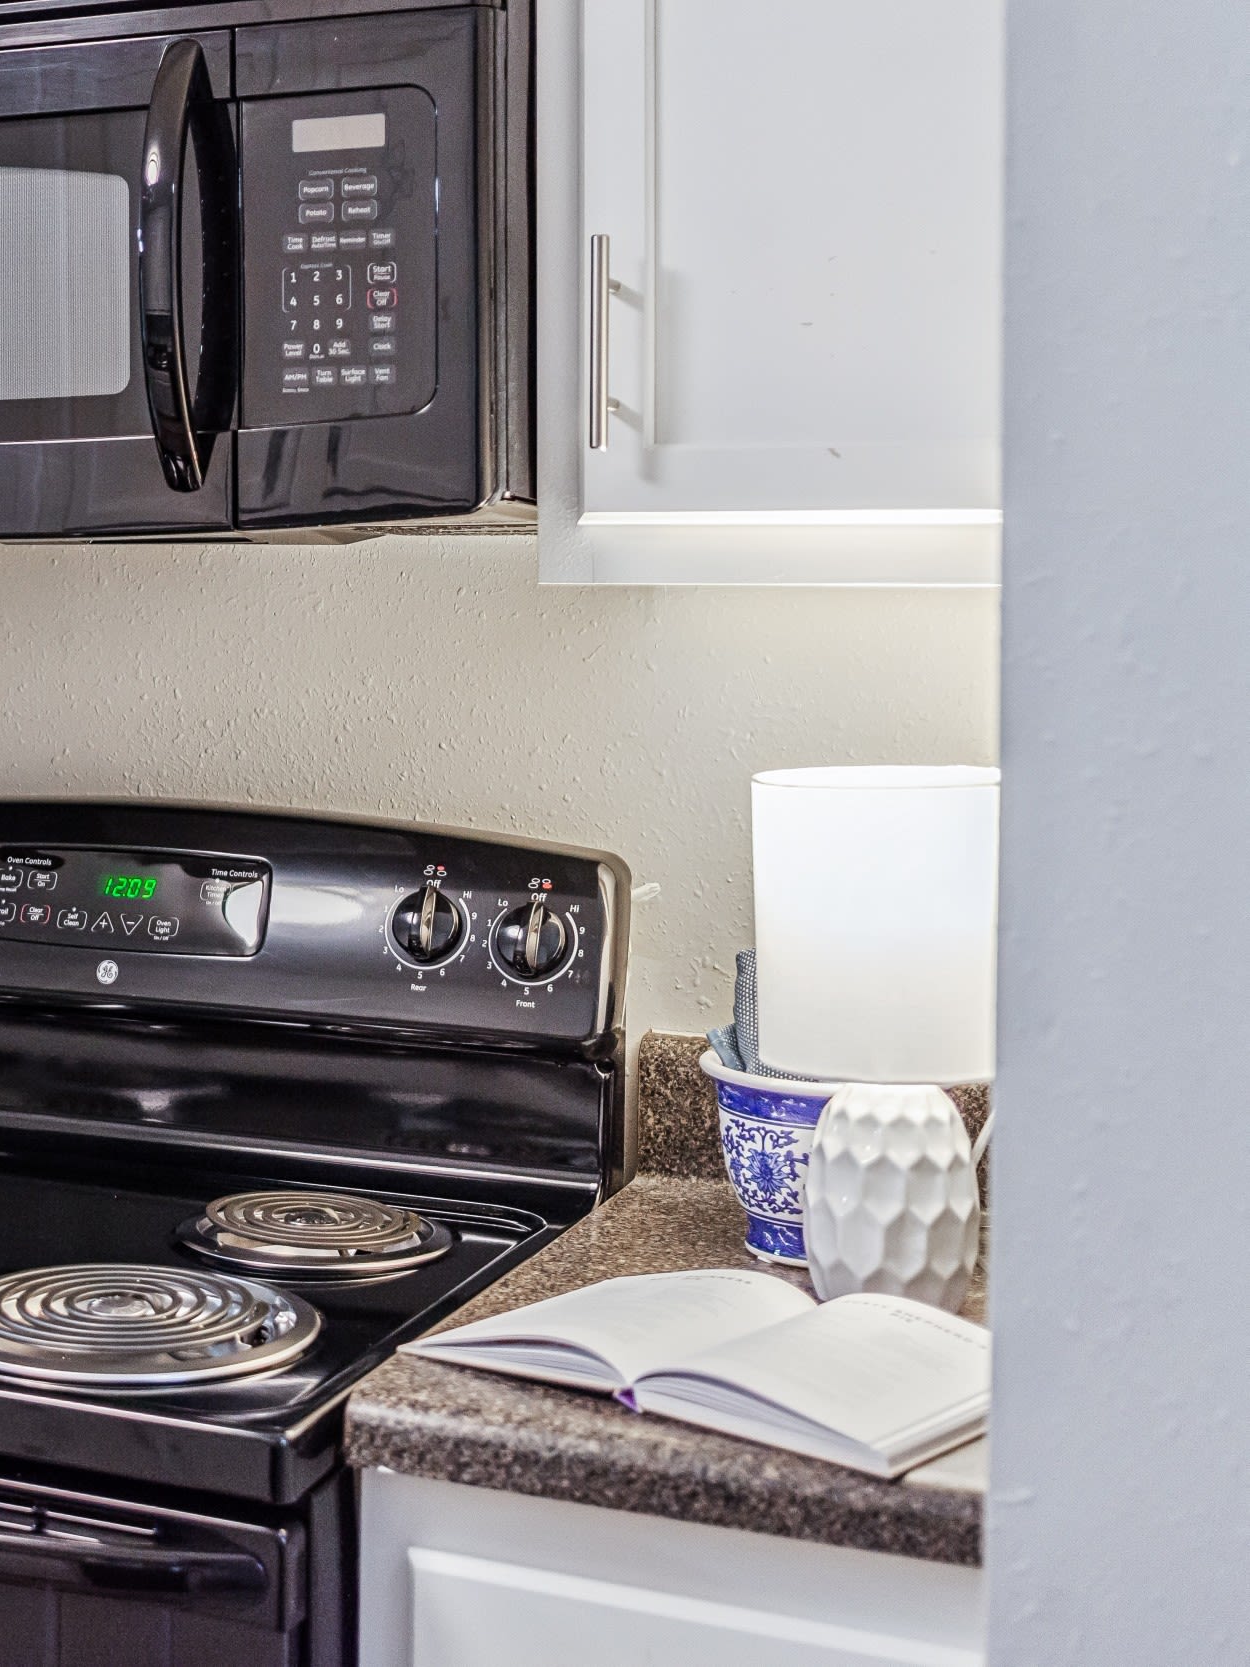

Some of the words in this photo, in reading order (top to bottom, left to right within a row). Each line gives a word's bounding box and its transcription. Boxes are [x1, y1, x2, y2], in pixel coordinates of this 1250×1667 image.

[303, 186, 329, 194] Popcorn
[344, 182, 375, 191] Beverage
[291, 272, 297, 282] 1
[313, 271, 320, 281] 2
[336, 270, 342, 280] 3
[290, 297, 297, 306] 4
[313, 295, 320, 306] 5
[336, 294, 343, 304] 6
[290, 320, 297, 331] 7
[313, 319, 320, 330] 8
[336, 318, 343, 329] 9
[313, 343, 320, 354] 0
[345, 375, 362, 383] Light
[7, 856, 24, 864] Oven
[25, 858, 52, 866] Controls
[211, 869, 228, 877] Time
[229, 870, 258, 878] Controls
[1, 874, 16, 882] Bake
[395, 885, 405, 893] Lo
[463, 891, 472, 899] Hi
[498, 899, 508, 907] Lo
[570, 905, 580, 913] Hi
[155, 926, 170, 934] Light
[411, 983, 427, 992] Rear
[516, 1000, 535, 1008] Front
